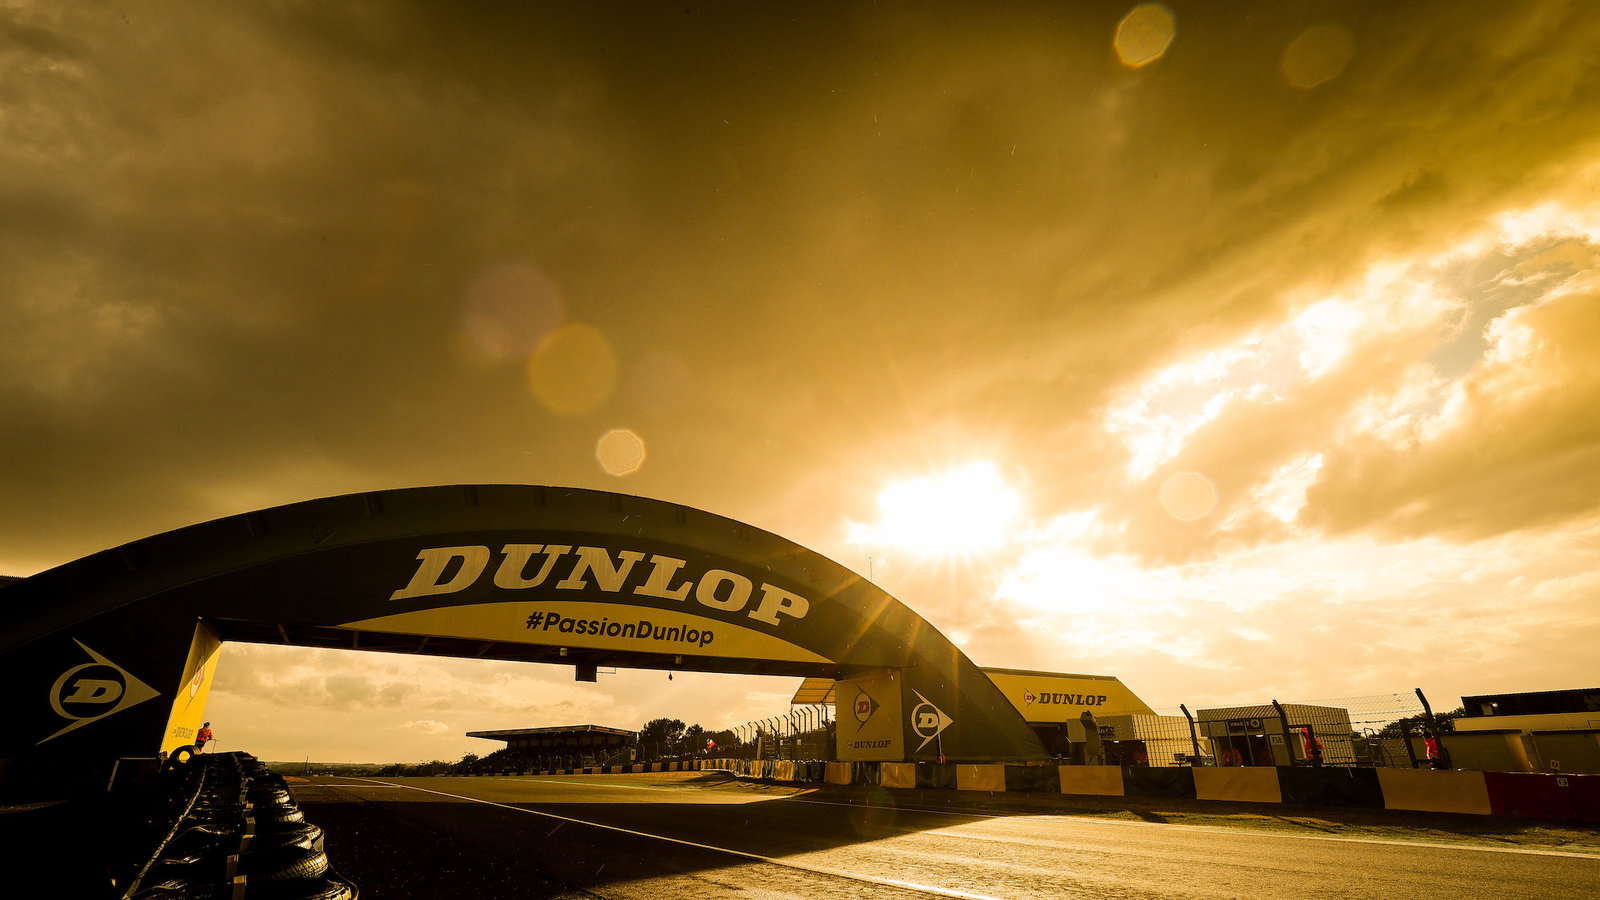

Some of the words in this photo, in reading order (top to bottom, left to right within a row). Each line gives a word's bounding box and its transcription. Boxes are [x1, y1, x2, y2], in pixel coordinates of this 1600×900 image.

[389, 544, 809, 627] DUNLOP
[526, 612, 714, 647] #PassionDunlop
[63, 679, 123, 703] D
[1038, 693, 1107, 706] DUNLOP
[854, 741, 891, 749] DUNLOP
